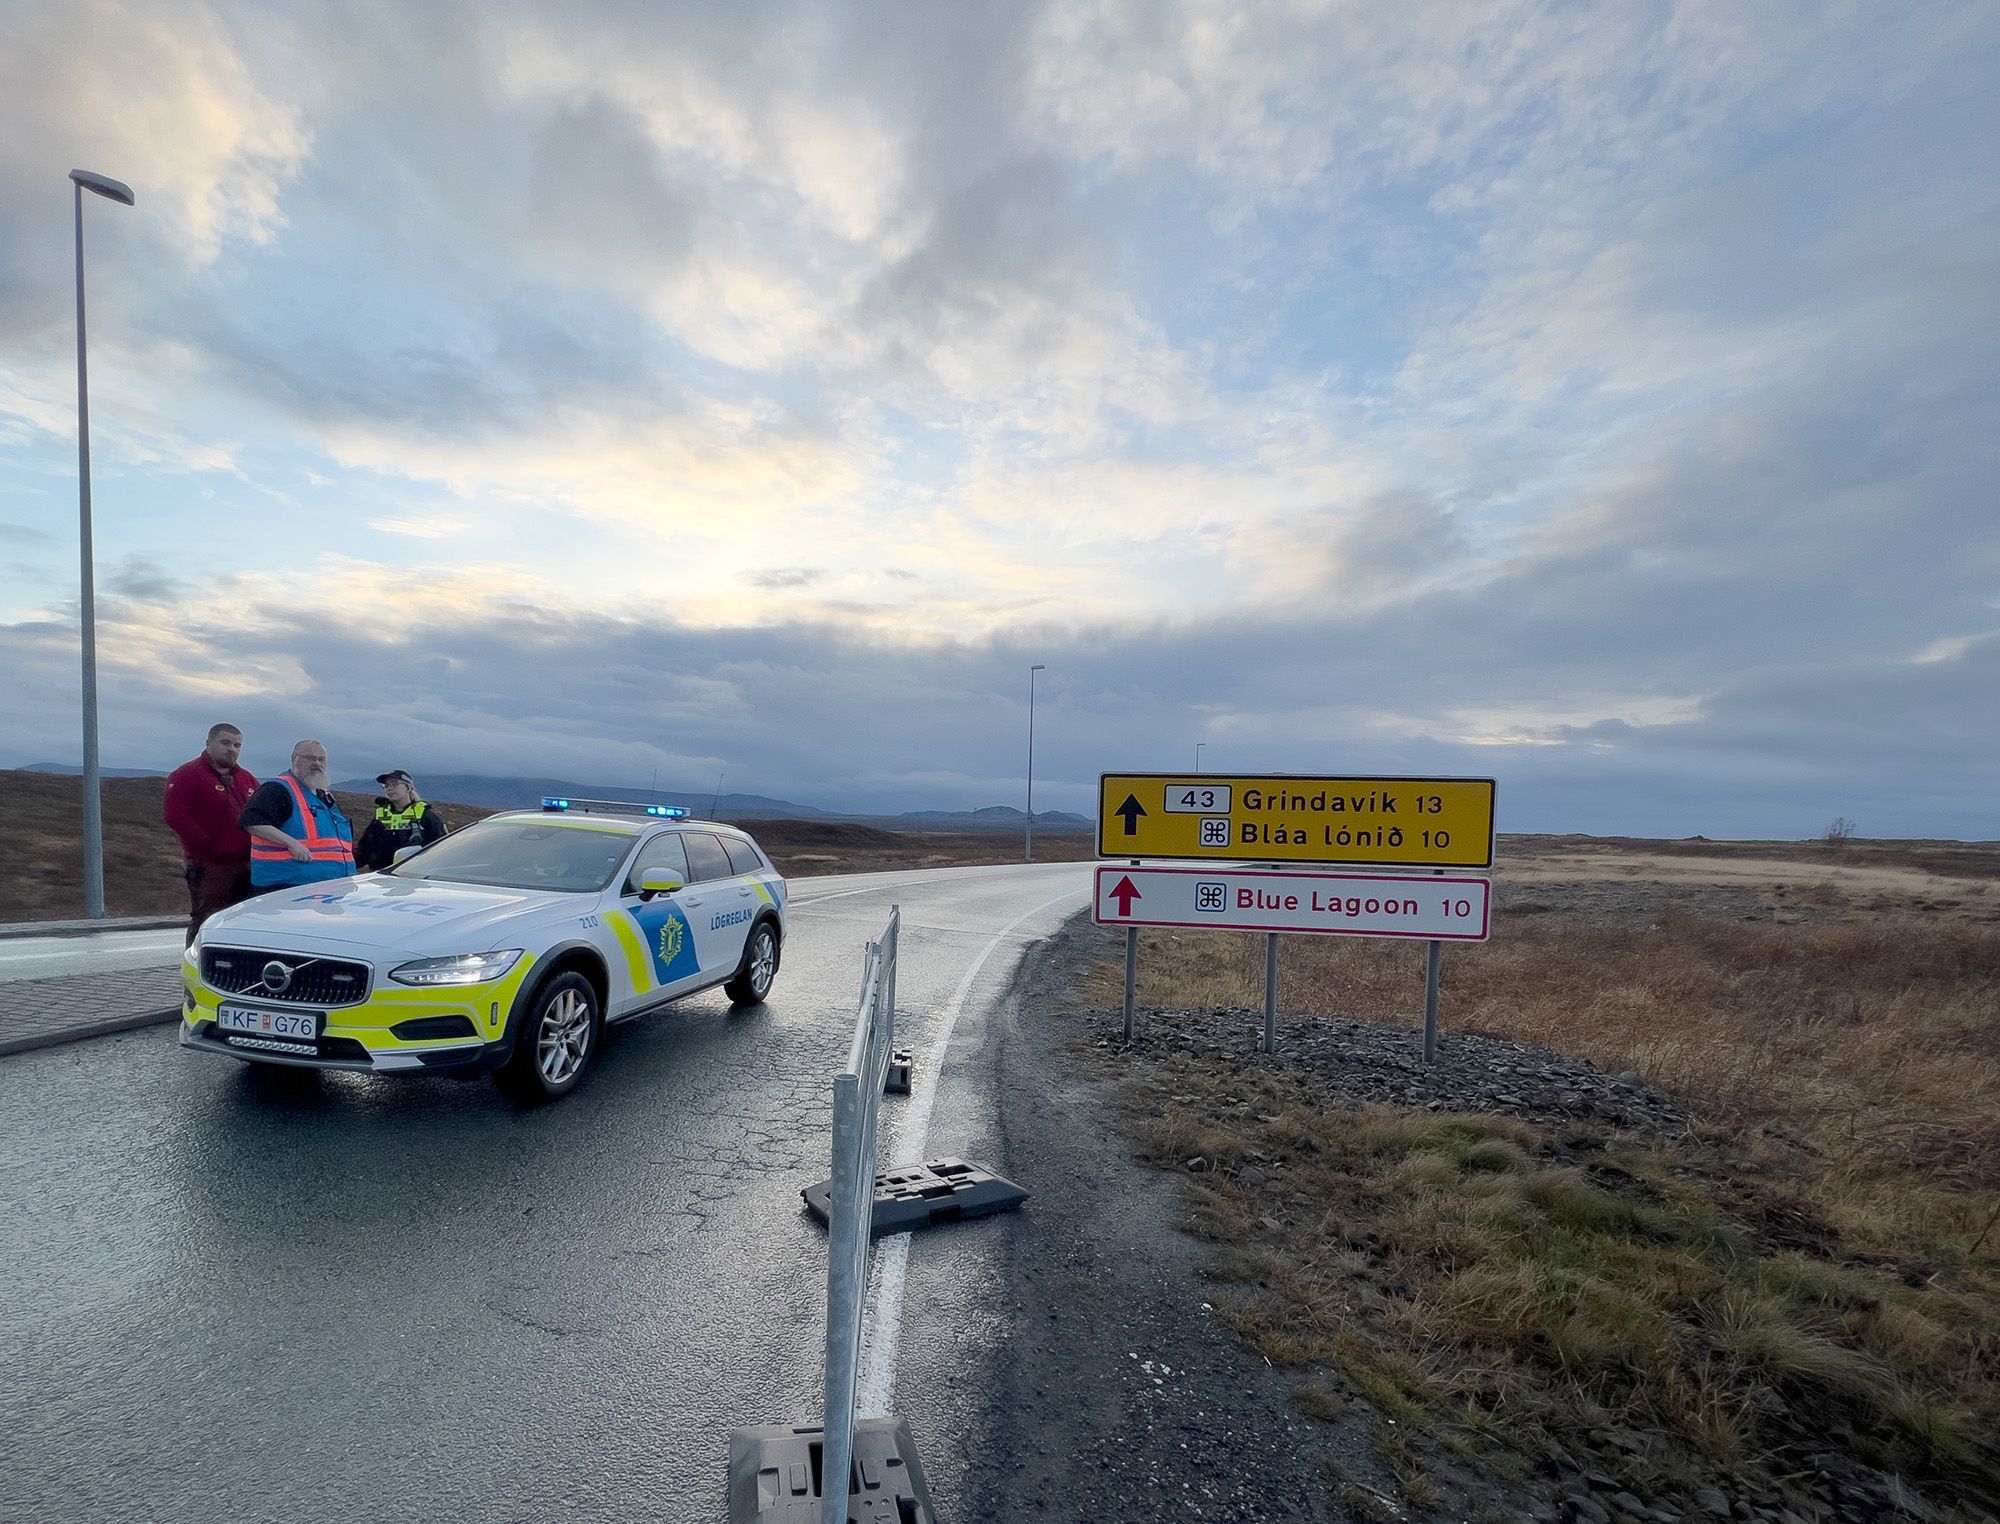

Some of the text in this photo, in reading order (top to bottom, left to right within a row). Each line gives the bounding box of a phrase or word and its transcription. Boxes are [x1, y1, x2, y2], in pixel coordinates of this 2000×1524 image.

[1181, 789, 1442, 814] 43 Grindavík 13
[1241, 823, 1450, 848] Bláa lónið 10
[1237, 889, 1471, 918] Blue Lagoon 10
[579, 915, 599, 929] 210
[711, 908, 752, 930] LÖGREGLAN
[233, 1010, 258, 1028] KF
[275, 1016, 312, 1035] G76
